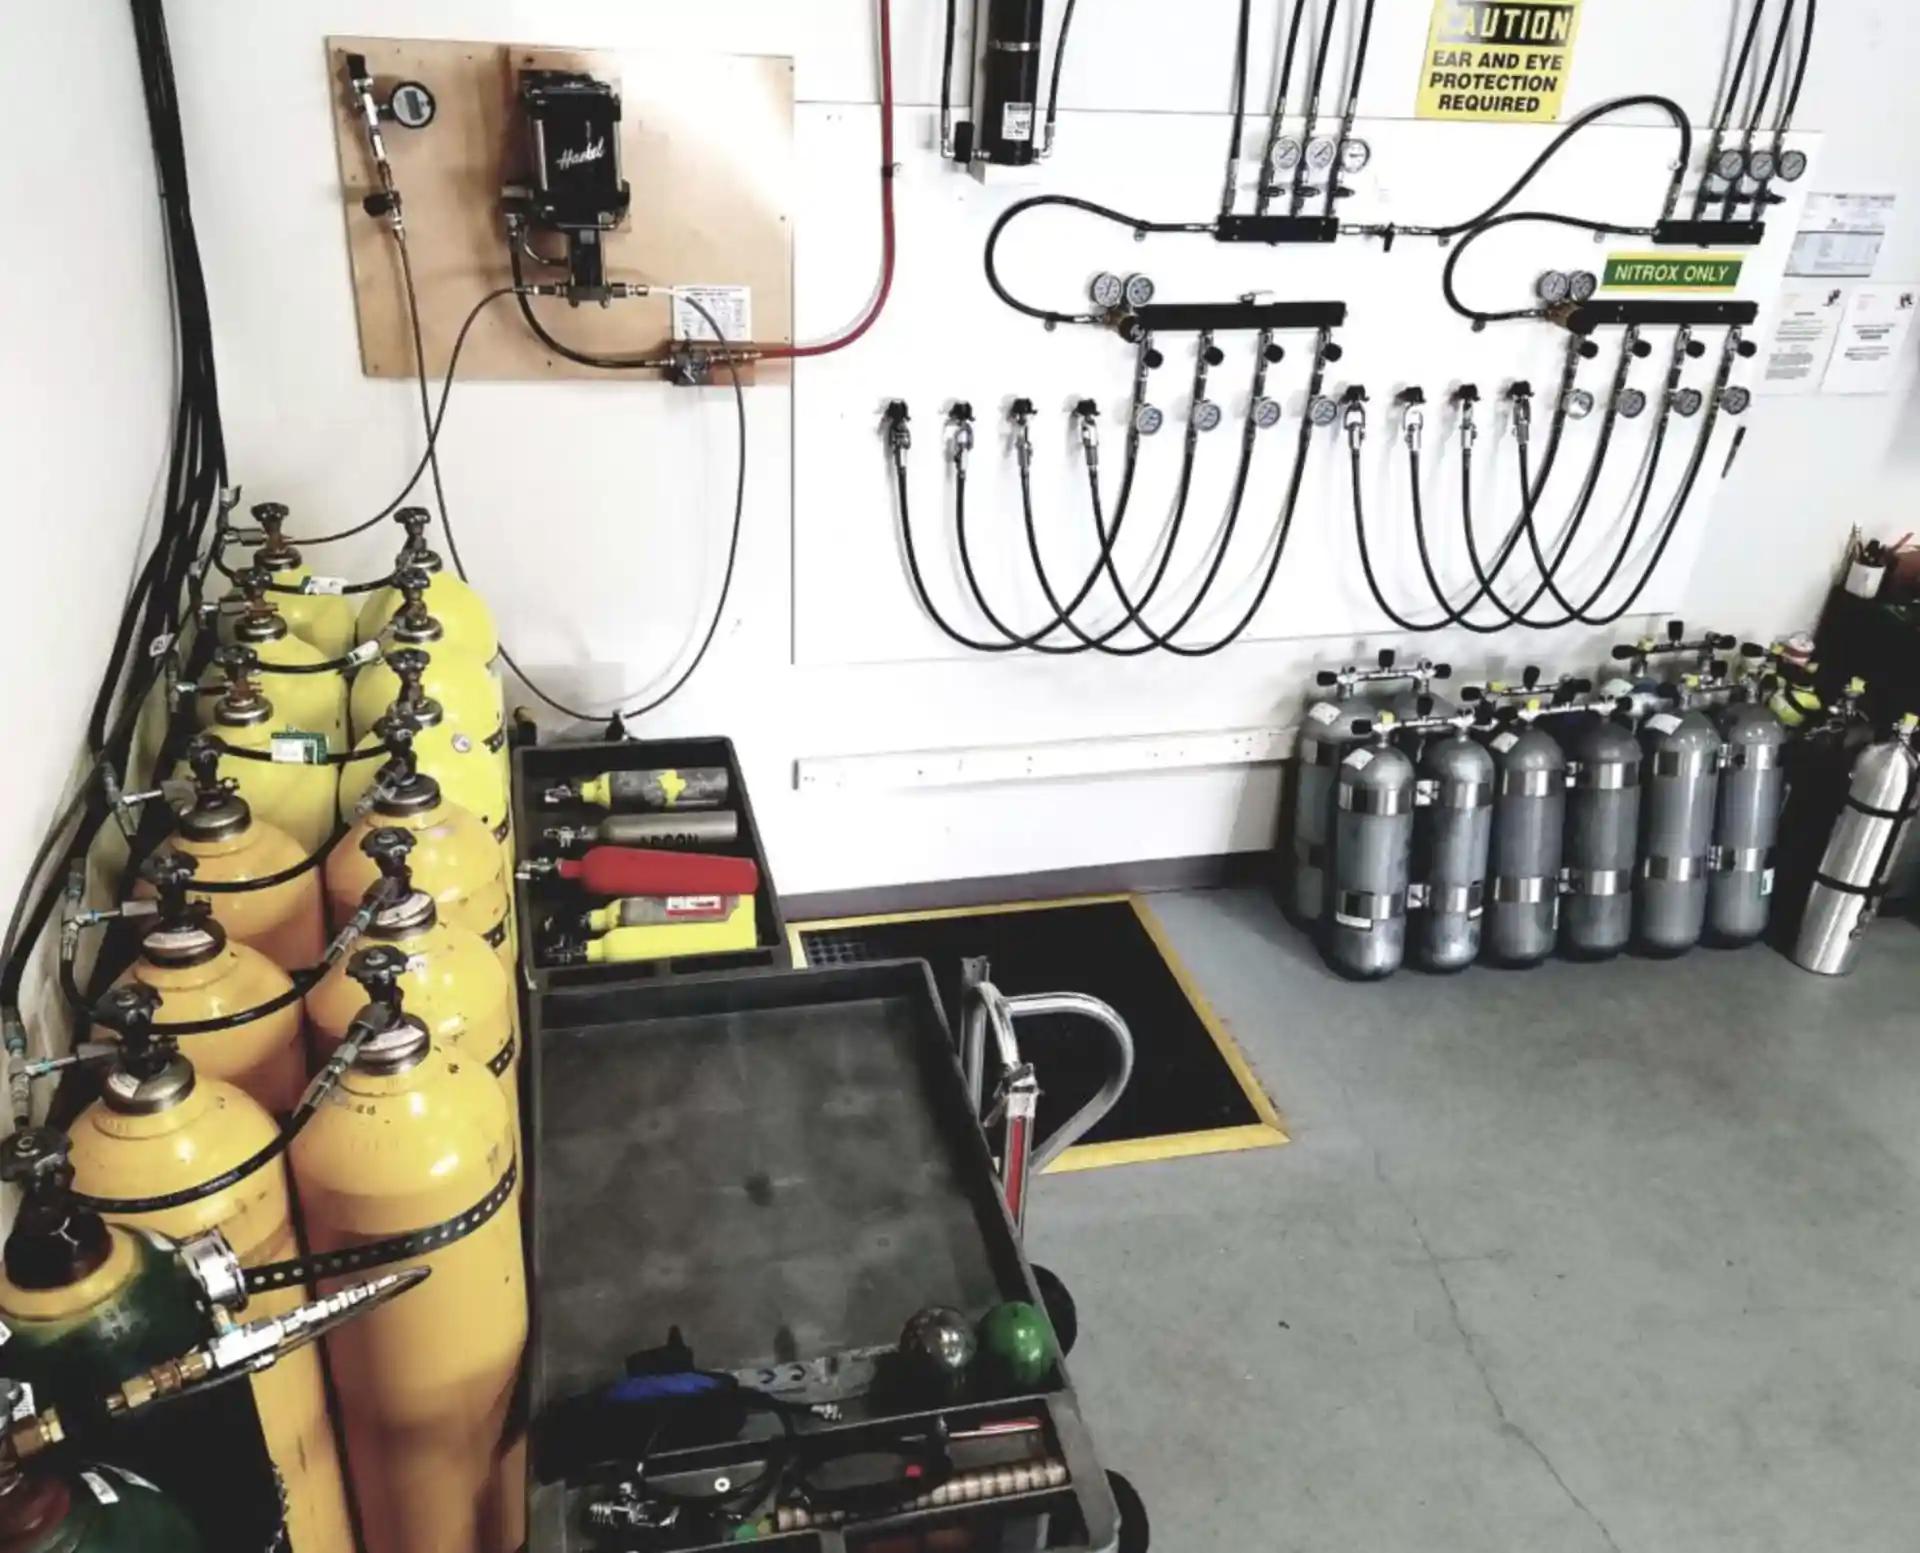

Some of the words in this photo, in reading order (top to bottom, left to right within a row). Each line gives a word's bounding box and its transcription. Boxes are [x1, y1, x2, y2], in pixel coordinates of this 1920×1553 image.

[1444, 7, 1571, 41] AUTION
[1433, 50, 1472, 67] EAR
[1478, 52, 1519, 69] AND
[1525, 54, 1564, 71] EYE
[1429, 73, 1557, 91] PROTECTION
[1438, 94, 1539, 112] REQUIRED
[1614, 264, 1679, 281] NITROX
[1684, 265, 1729, 282] ONLY
